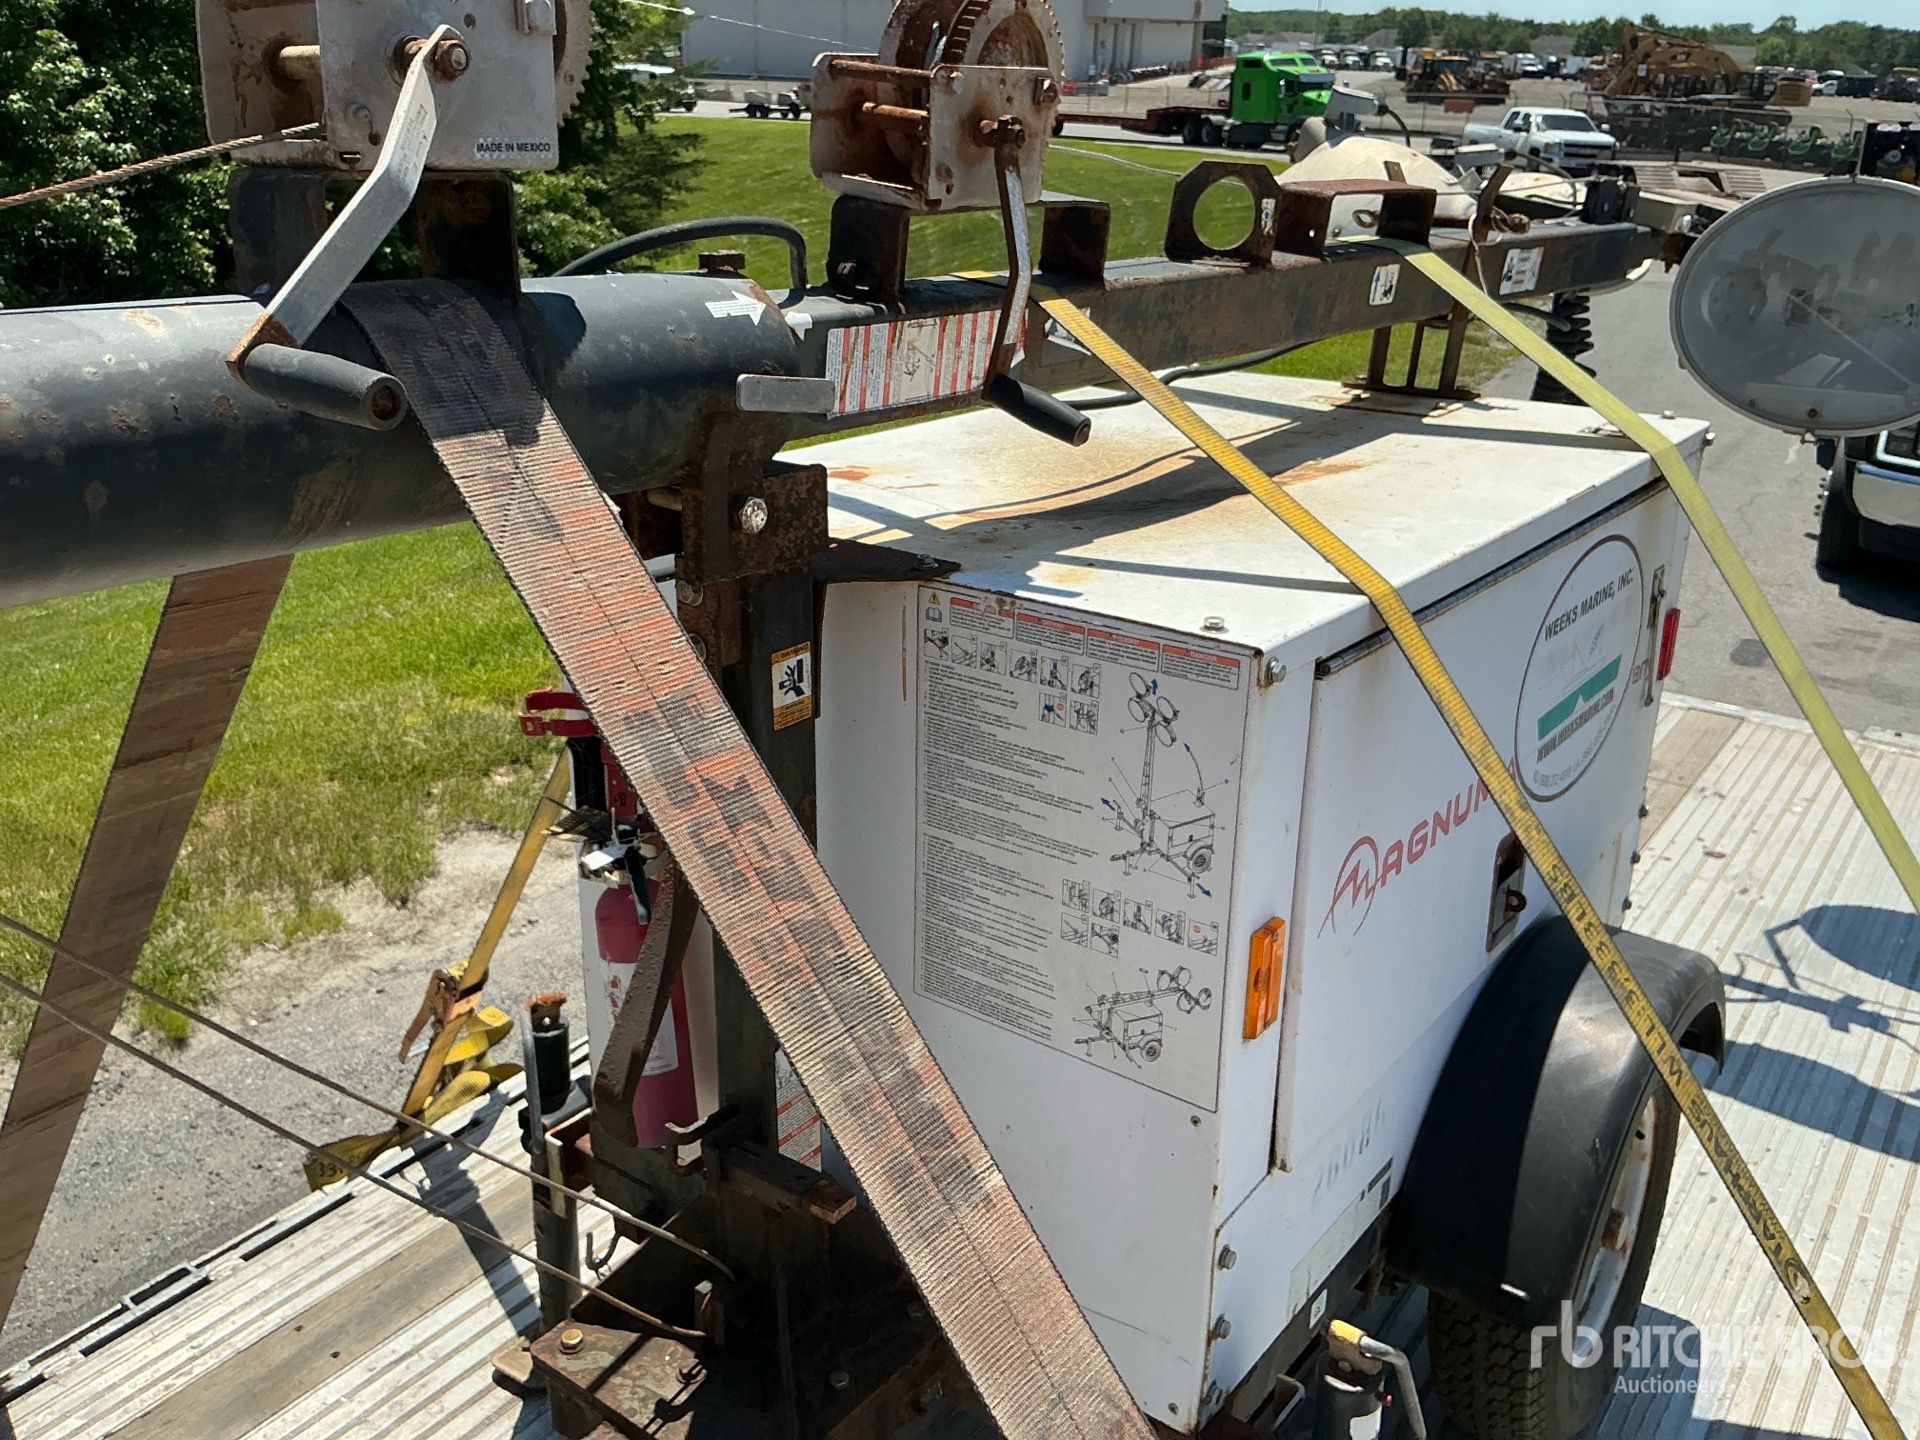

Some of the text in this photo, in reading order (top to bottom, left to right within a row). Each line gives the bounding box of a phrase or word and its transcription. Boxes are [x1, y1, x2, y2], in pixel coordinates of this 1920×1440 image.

[477, 142, 551, 152] MADE IN MEXICO
[1544, 568, 1634, 642] WEEKS MARINE, INC.
